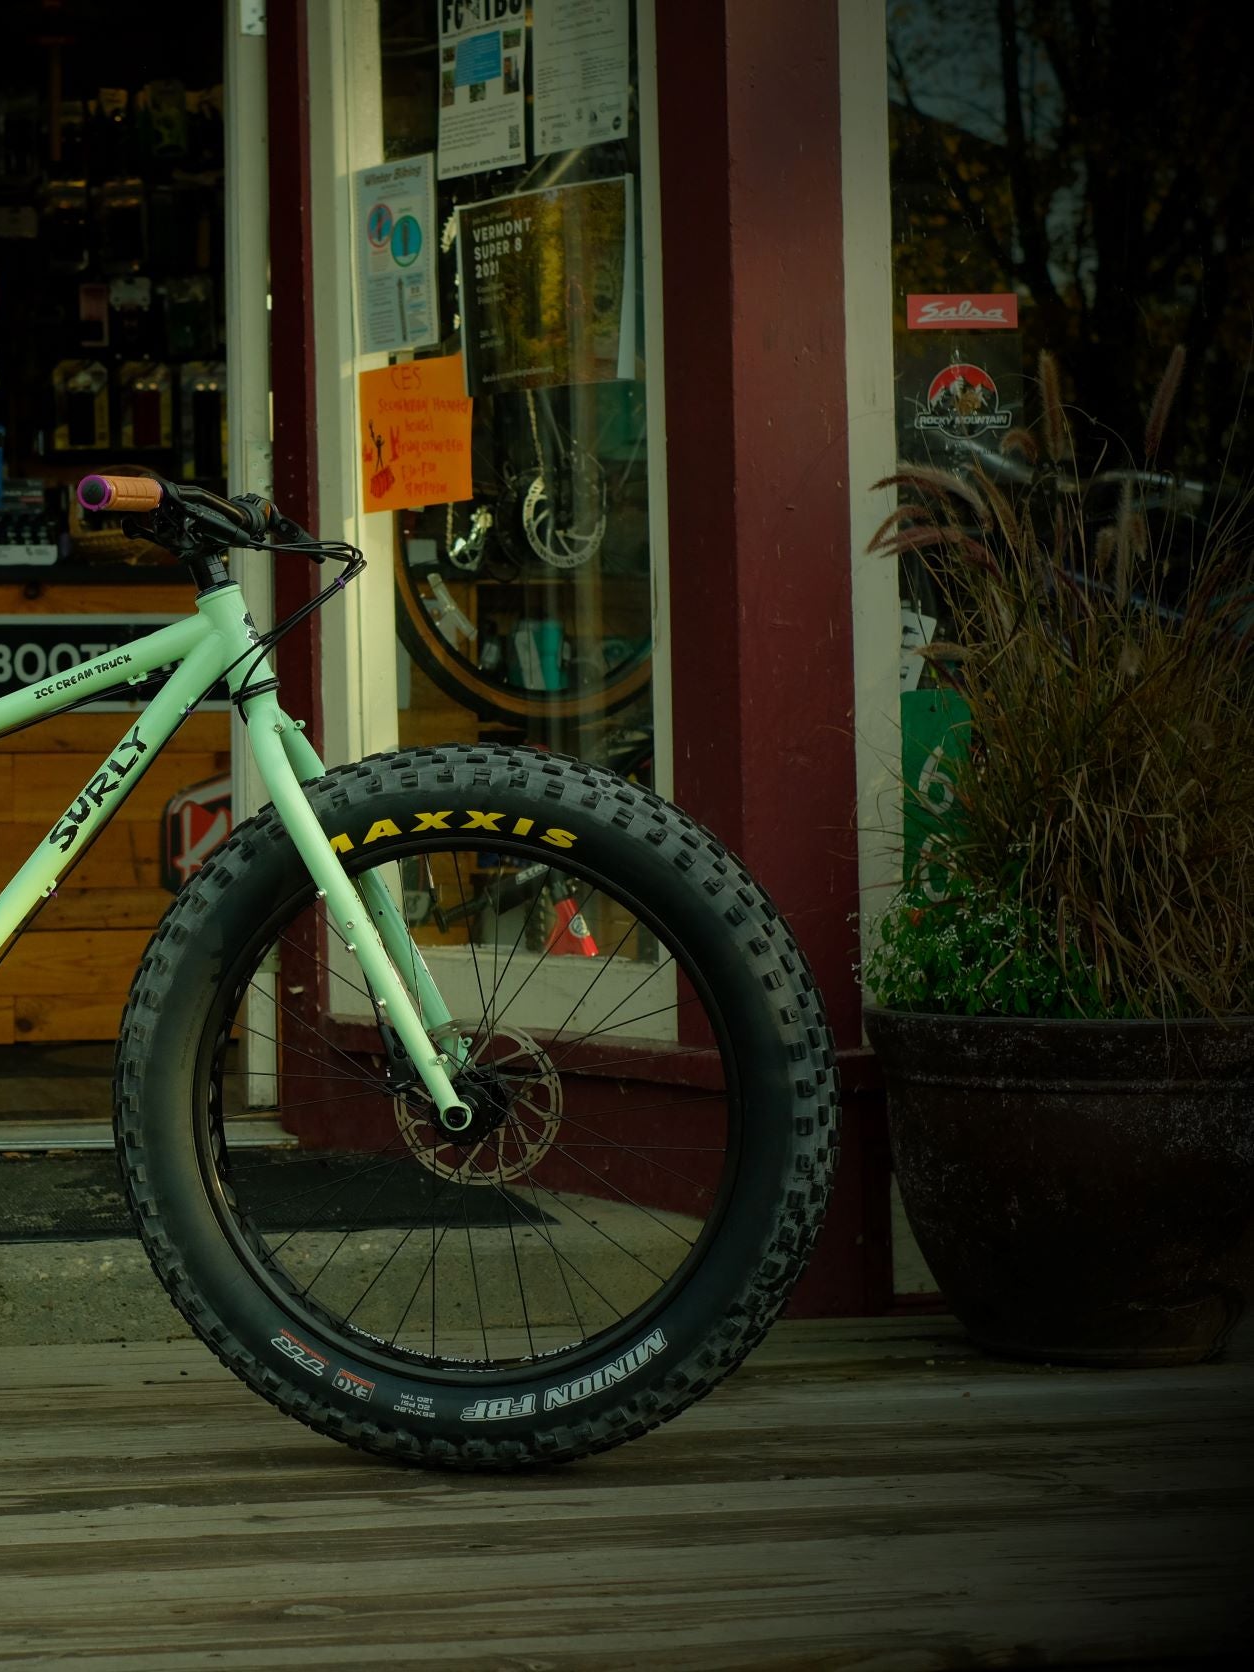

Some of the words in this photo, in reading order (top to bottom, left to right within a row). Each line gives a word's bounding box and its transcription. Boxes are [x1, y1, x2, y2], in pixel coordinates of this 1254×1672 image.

[472, 217, 532, 243] VERMONT
[473, 240, 510, 262] SUPER
[514, 237, 523, 252] 8
[475, 260, 500, 280] 2021
[917, 300, 1008, 323] Salsa
[920, 415, 953, 425] ROCKY
[954, 414, 1008, 426] MOUNTAIN
[34, 683, 55, 700] ICE
[56, 667, 94, 691] CREAM
[94, 653, 133, 675] TRUCK
[49, 726, 149, 853] SURLY
[544, 1328, 668, 1411] MINION
[401, 1392, 415, 1401] TPI
[401, 1399, 419, 1409] PSI
[416, 1395, 434, 1403] 120
[420, 1402, 434, 1411] 20
[460, 1393, 536, 1421] FBF
